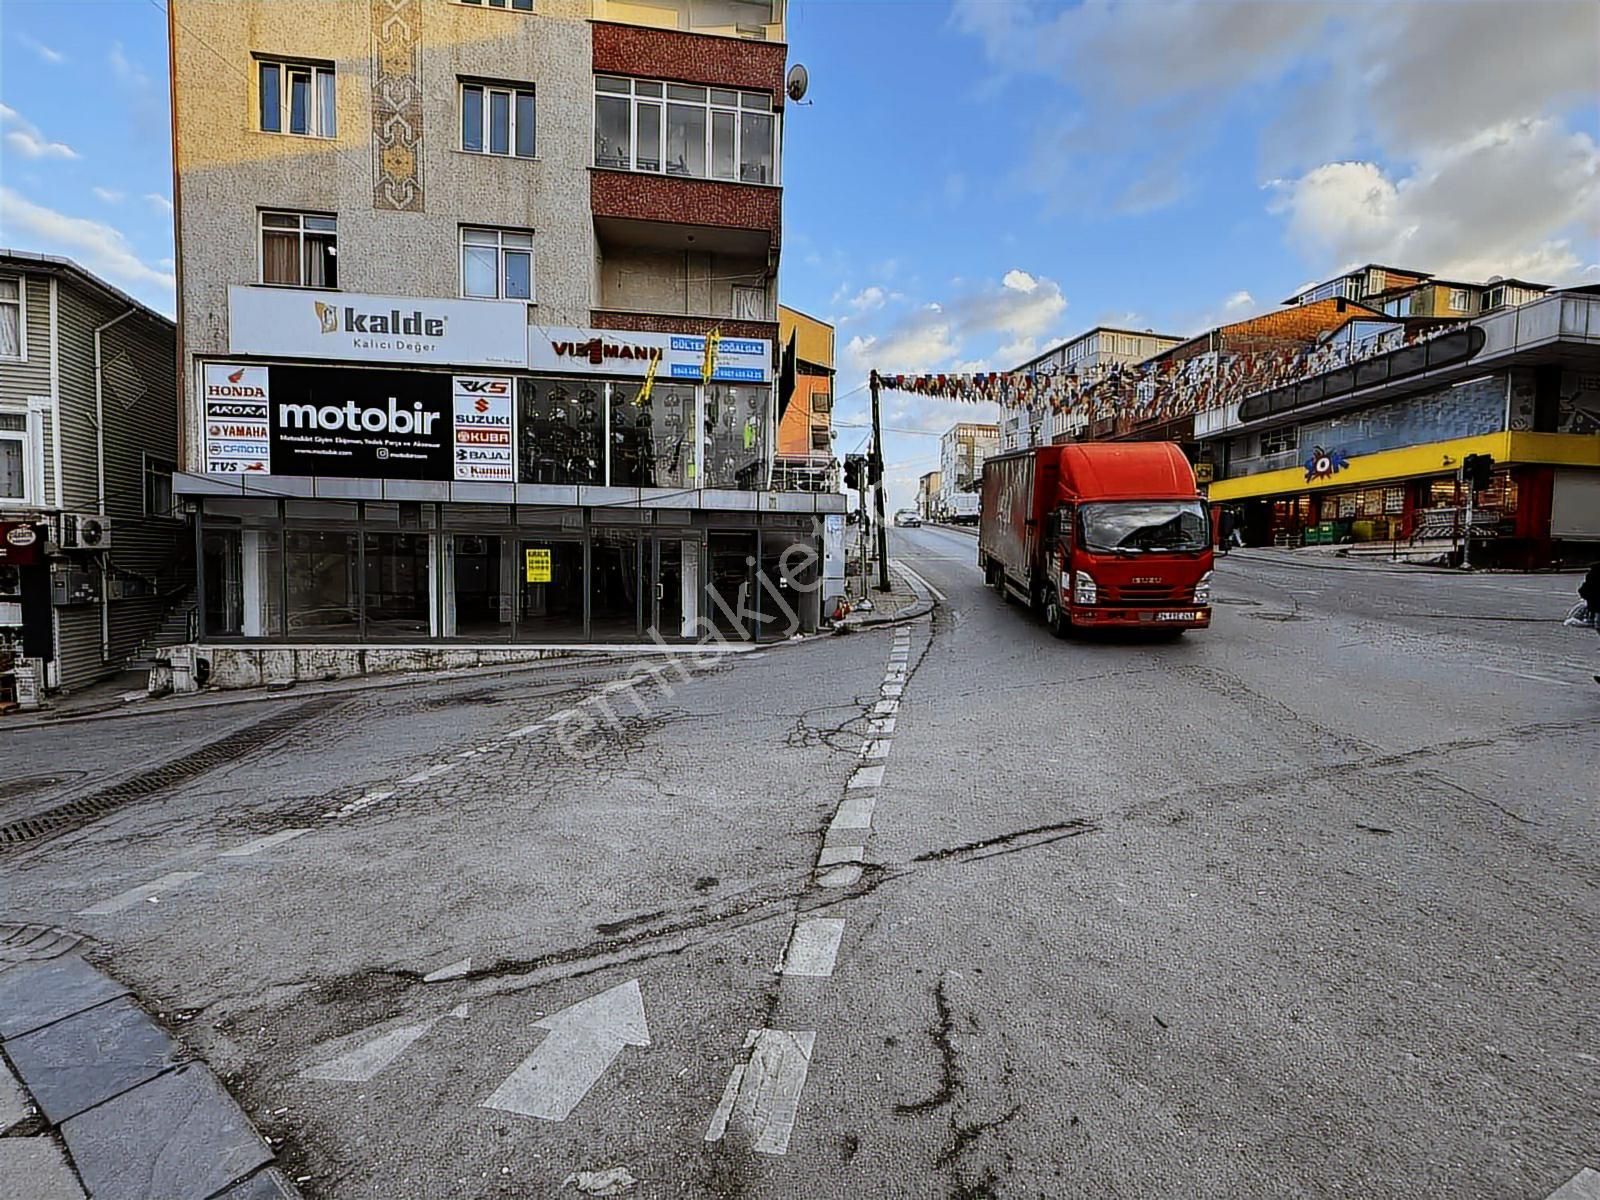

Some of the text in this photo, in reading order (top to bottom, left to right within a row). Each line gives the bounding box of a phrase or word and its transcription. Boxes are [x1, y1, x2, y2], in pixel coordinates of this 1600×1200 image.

[345, 307, 443, 336] kalde
[353, 338, 436, 352] Kalıcı Değer
[208, 385, 266, 397] HONDA
[457, 380, 509, 393] RKS
[209, 405, 267, 416] ARORA
[279, 397, 440, 435] motobir
[456, 414, 510, 425] SUZUKI
[222, 425, 268, 437] YAMAHA
[470, 432, 509, 443] KUBA
[223, 445, 268, 454] CFMOTO
[469, 451, 511, 460] BAJAJ
[210, 462, 238, 472] TVS
[471, 466, 511, 475] Kanuni
